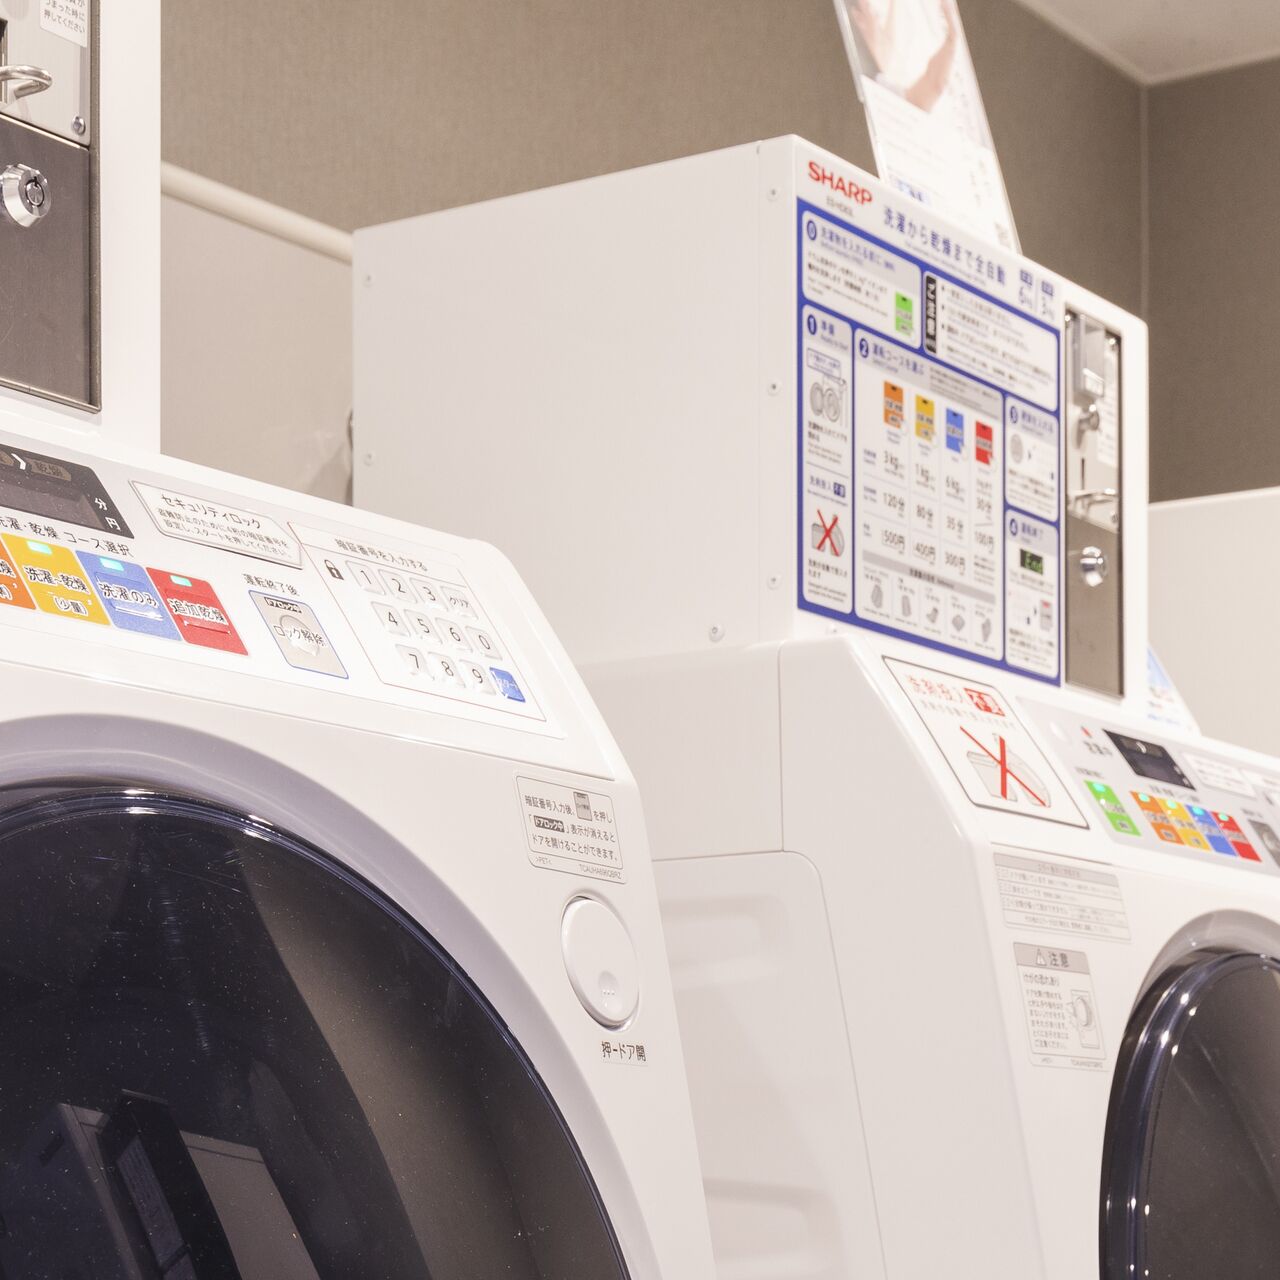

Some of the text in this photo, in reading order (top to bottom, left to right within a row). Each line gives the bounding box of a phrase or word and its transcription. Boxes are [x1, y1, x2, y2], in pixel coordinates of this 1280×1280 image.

[808, 160, 872, 206] SHARP
[105, 516, 121, 531] 円
[161, 494, 261, 530] セキュリティロック
[64, 532, 134, 558] コース選択
[335, 538, 428, 572] 暗証番号を入力する
[99, 582, 158, 608] 洗濯のみ
[242, 573, 300, 597] 運転終了後
[360, 570, 372, 584] 1
[392, 578, 406, 594] 2
[422, 586, 436, 601] 3
[170, 599, 226, 622] 追加乾燥
[274, 625, 325, 646] ロック解除
[388, 612, 490, 650] 4 5 6 0
[408, 653, 483, 684] 7 8 9
[593, 810, 612, 824] を押し
[532, 834, 618, 861] ドアを開けることができます。
